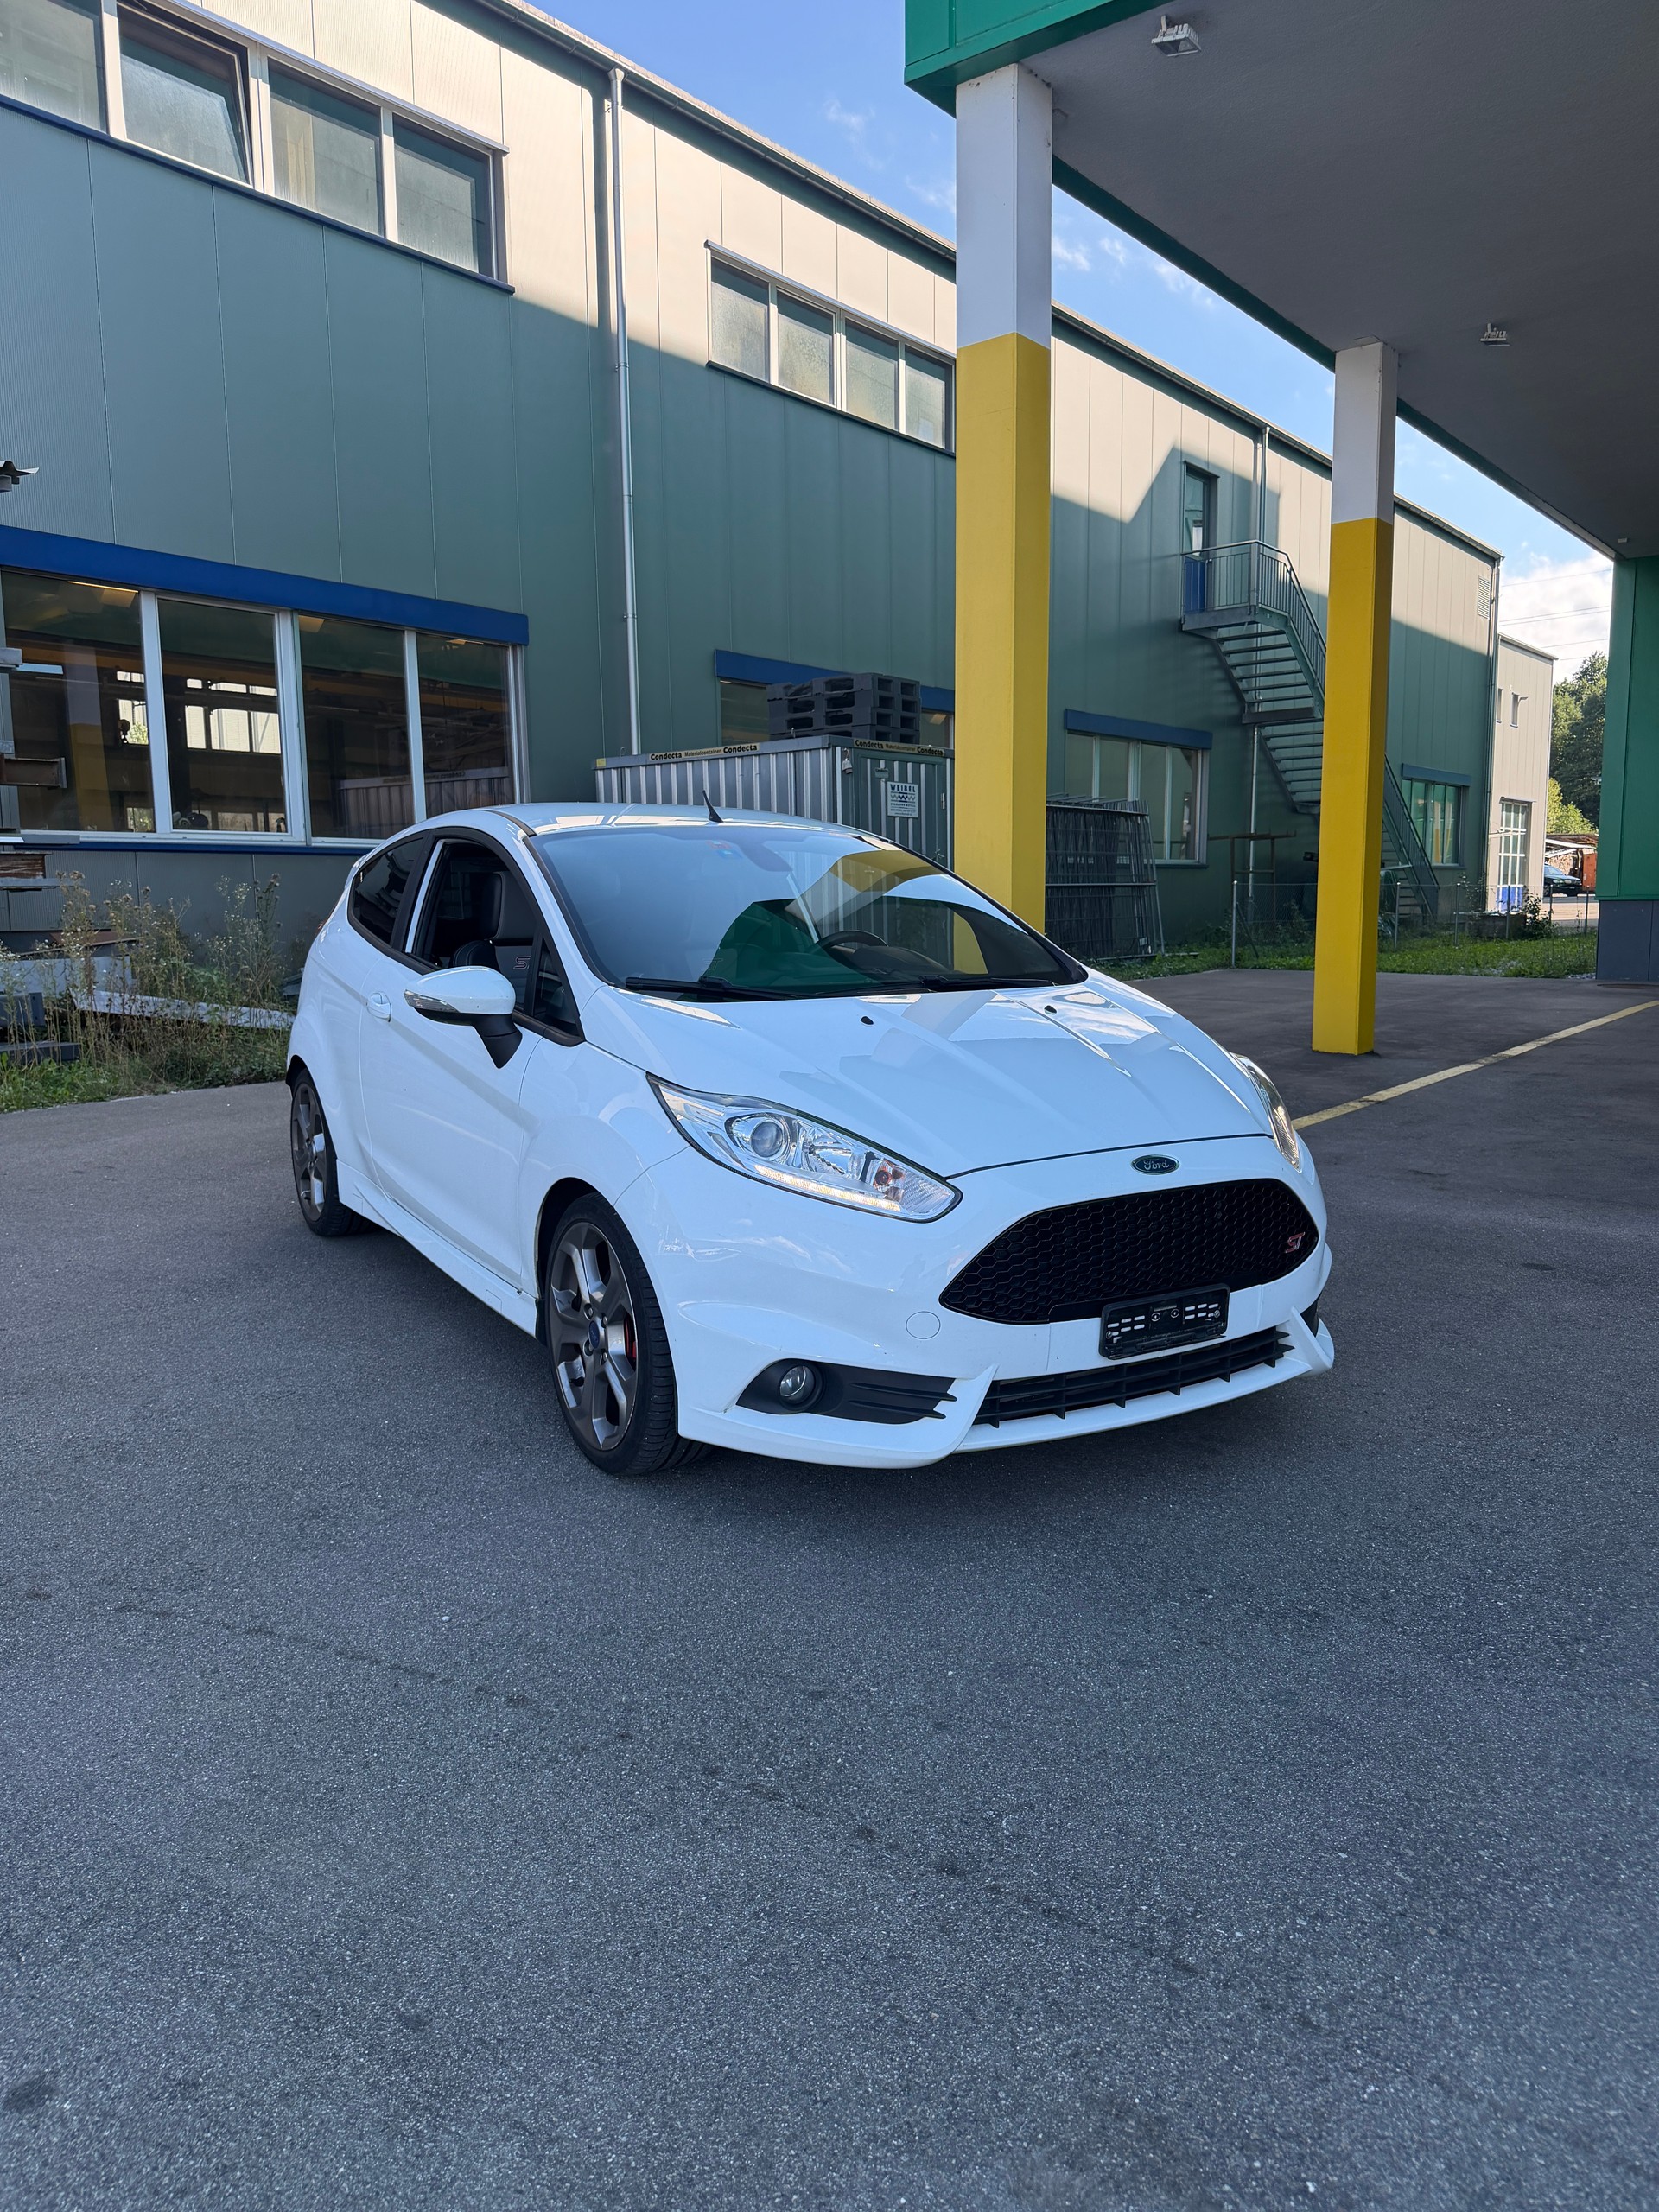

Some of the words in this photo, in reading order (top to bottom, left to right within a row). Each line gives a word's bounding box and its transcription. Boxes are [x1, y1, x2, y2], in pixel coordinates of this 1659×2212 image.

[650, 752, 683, 760] Condecta
[683, 748, 721, 757] Materialcontainer
[722, 744, 758, 753] Condecta
[855, 739, 883, 749] Condecta
[917, 746, 944, 755] Condecta
[890, 783, 916, 793] WEIBEL
[512, 955, 531, 969] S
[1143, 1158, 1170, 1171] Ford
[1285, 1231, 1306, 1254] ST
